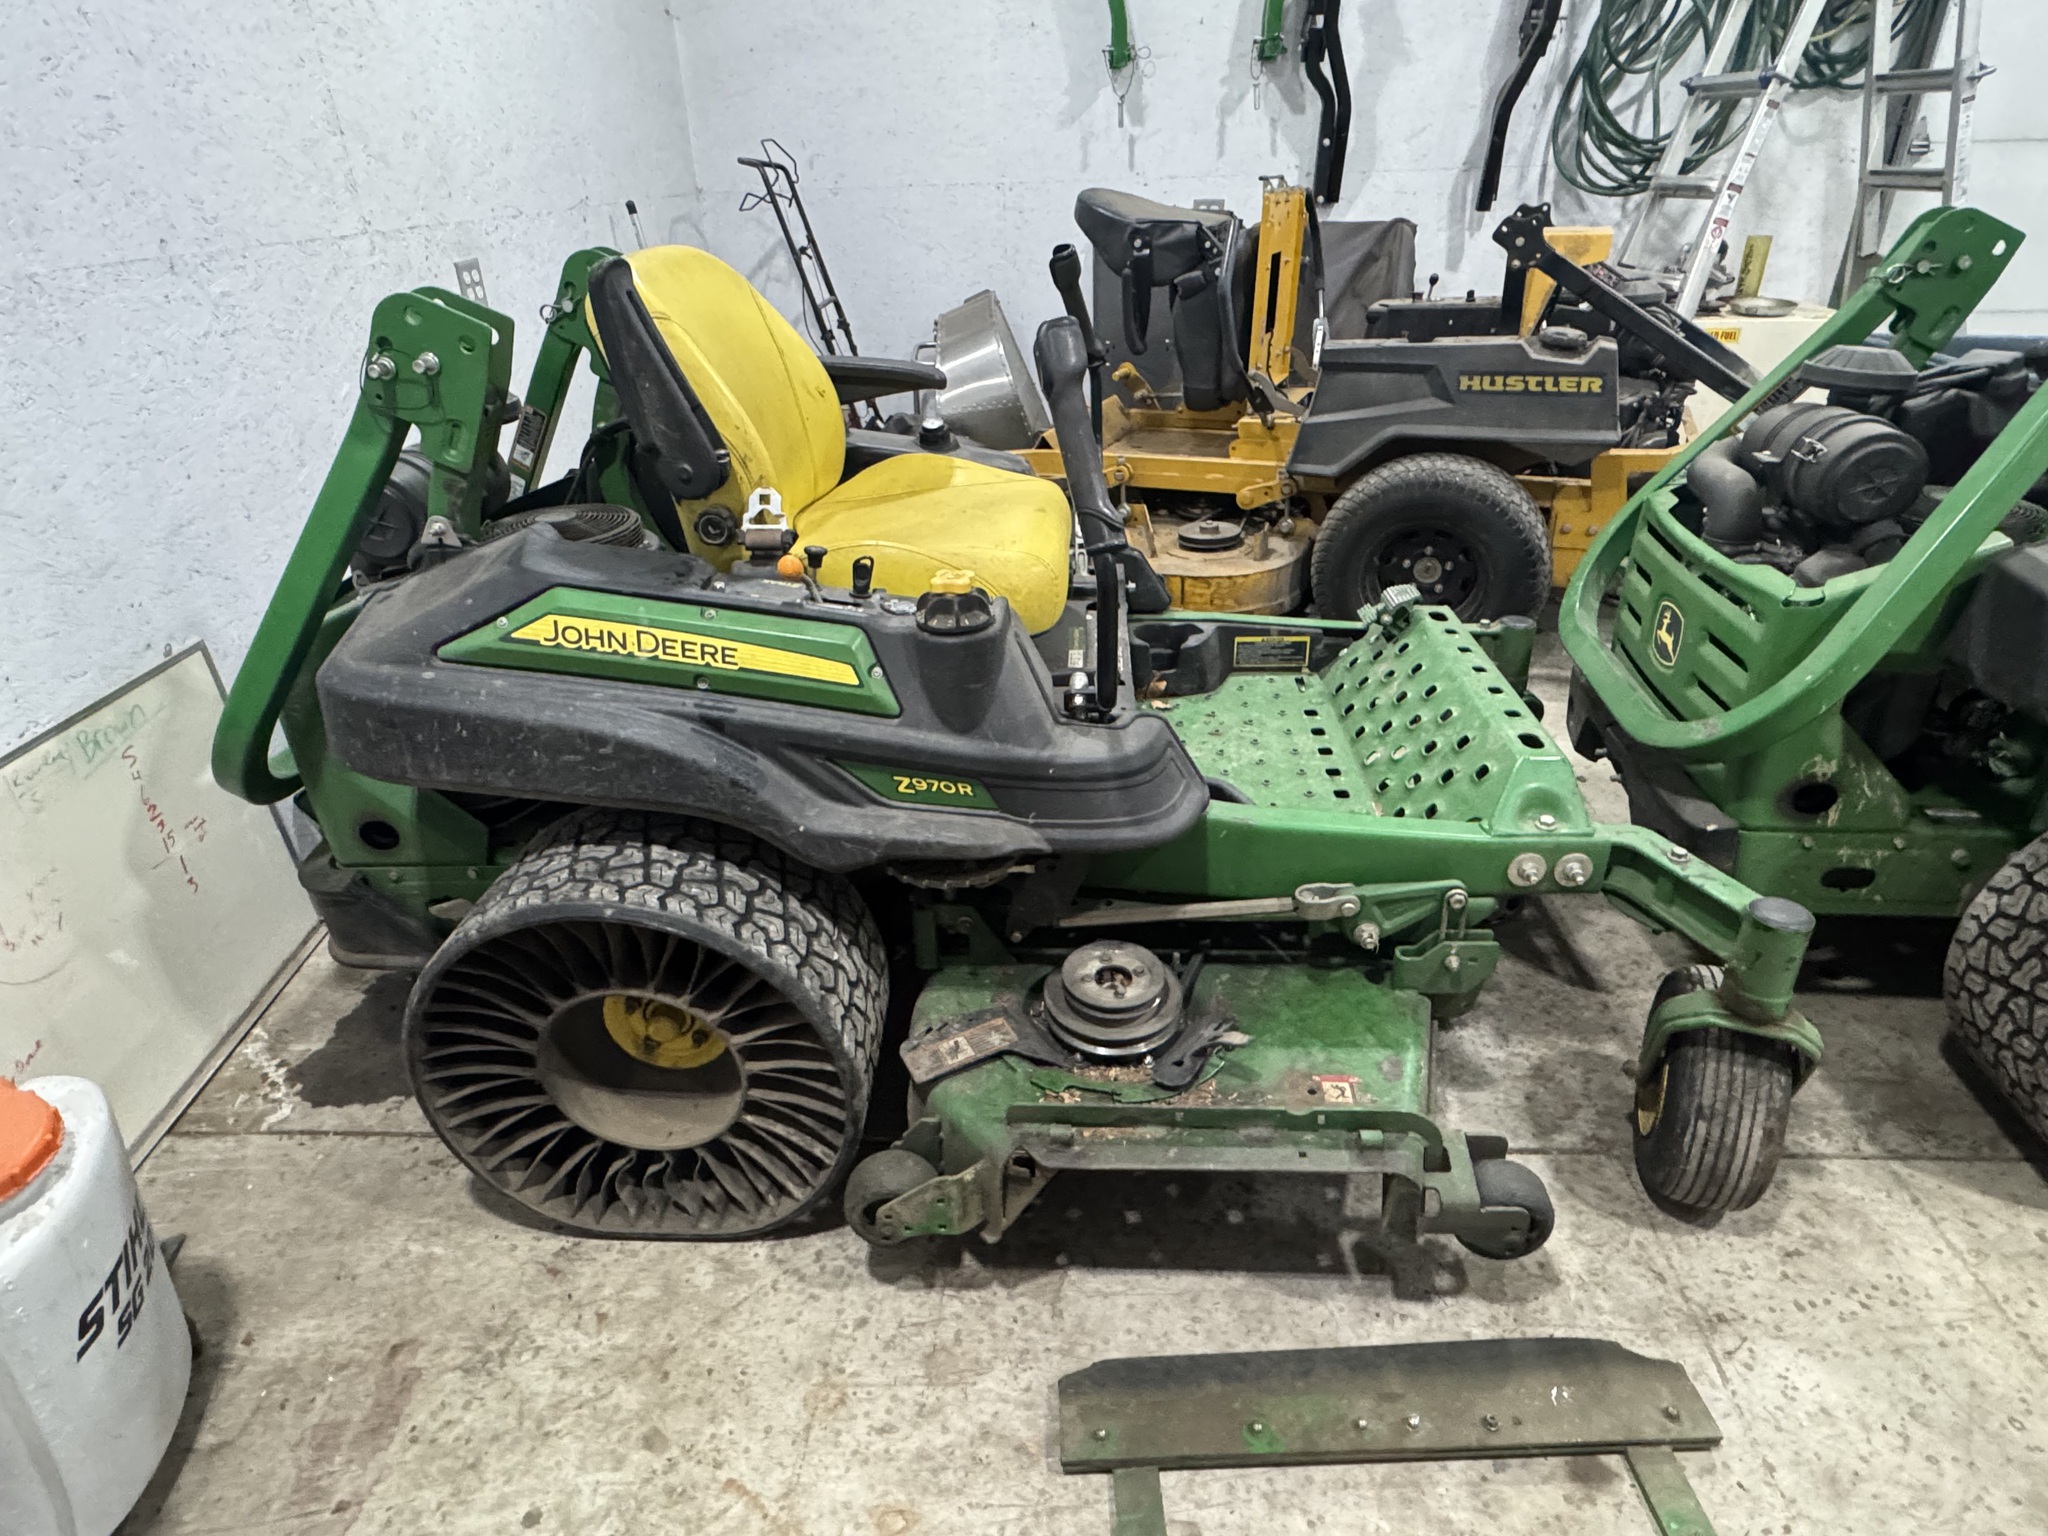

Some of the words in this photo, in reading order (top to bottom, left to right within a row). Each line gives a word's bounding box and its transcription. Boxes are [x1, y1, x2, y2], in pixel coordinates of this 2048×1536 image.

[1720, 331, 1737, 340] FUEL
[1459, 375, 1603, 393] HUSTLER
[543, 620, 627, 651] JOHN
[636, 629, 739, 667] DEERE
[893, 776, 973, 797] Z970R
